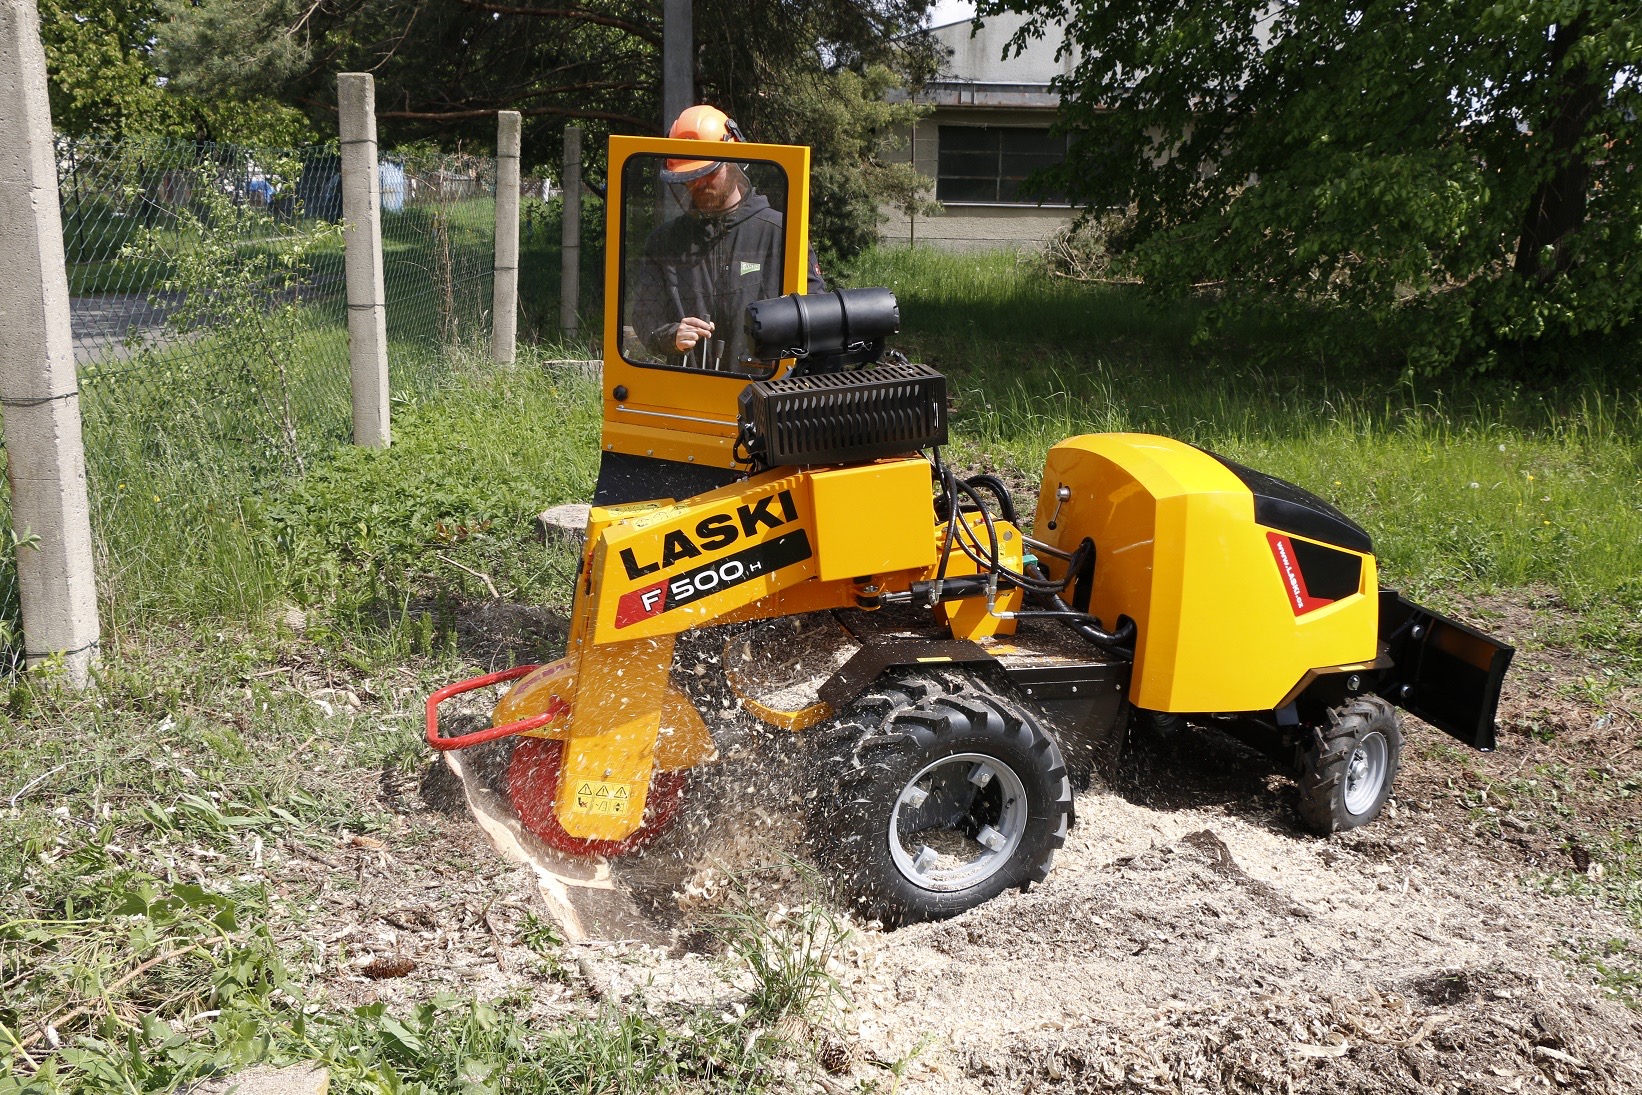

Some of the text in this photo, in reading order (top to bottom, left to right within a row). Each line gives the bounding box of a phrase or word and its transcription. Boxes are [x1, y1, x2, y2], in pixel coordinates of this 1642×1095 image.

[620, 490, 798, 580] LASKI
[641, 560, 762, 612] F 500 H
